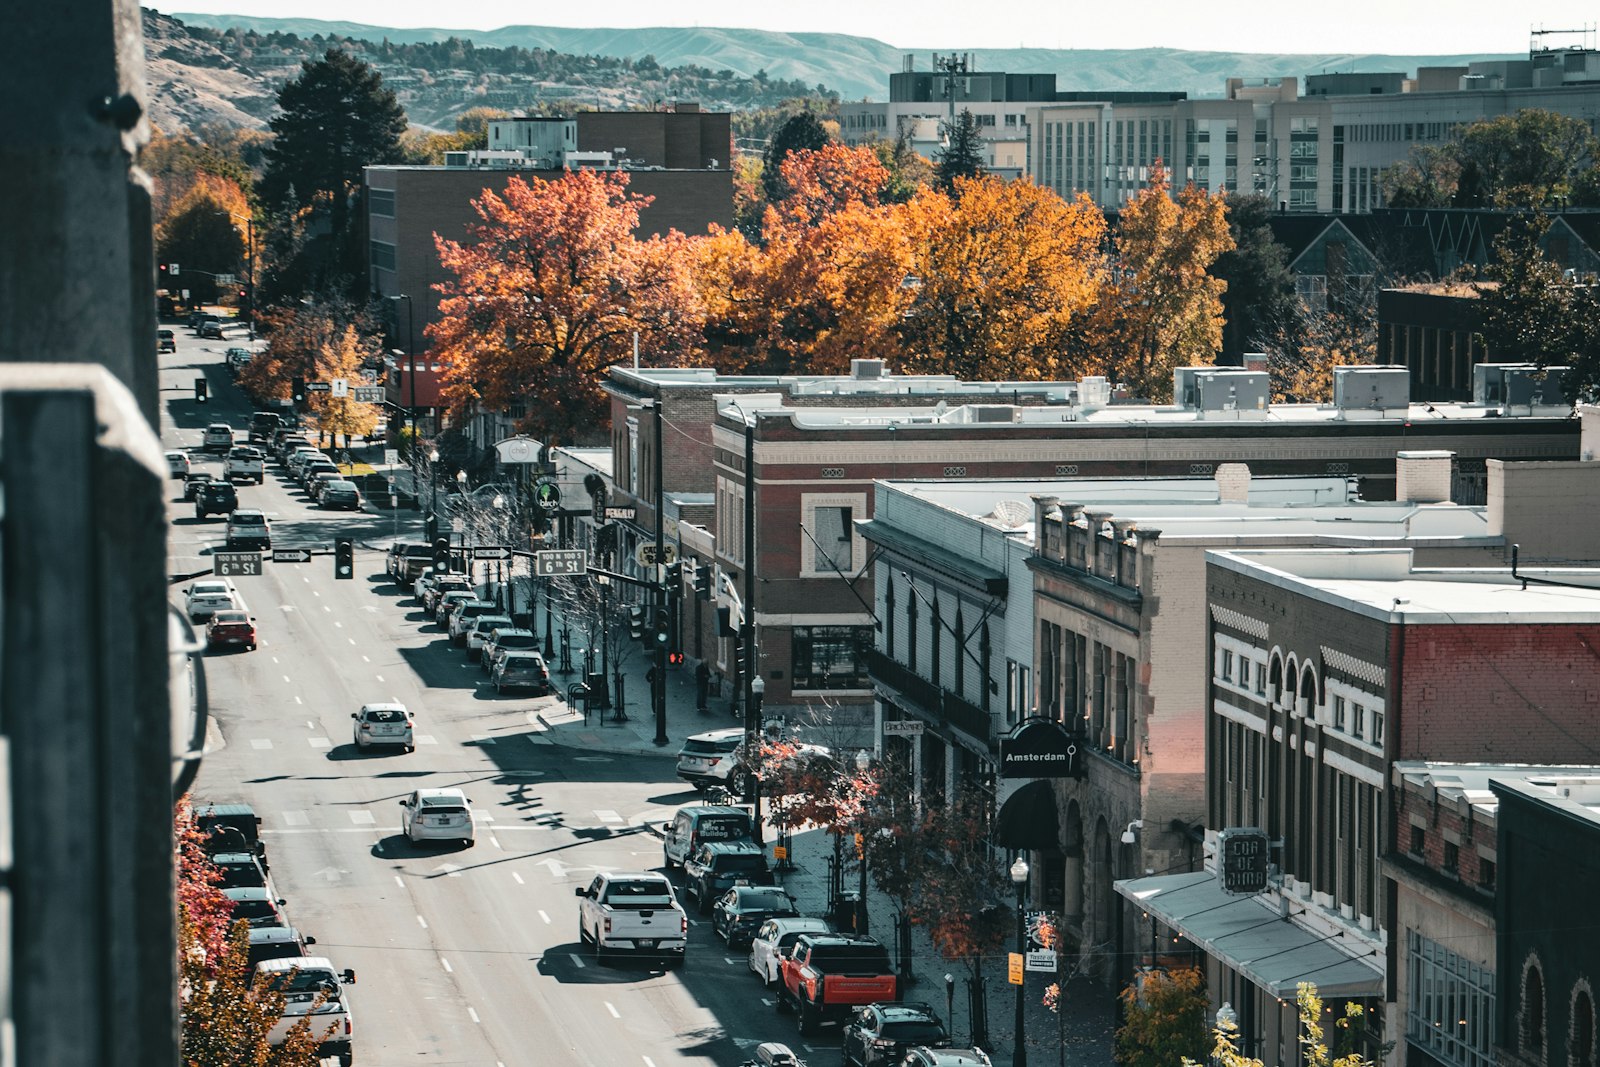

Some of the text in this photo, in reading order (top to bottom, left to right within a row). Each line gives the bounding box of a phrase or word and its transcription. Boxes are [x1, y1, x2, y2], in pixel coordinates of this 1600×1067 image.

[540, 499, 558, 507] birch
[221, 563, 229, 574] 6
[243, 562, 255, 574] St
[545, 561, 553, 573] 6
[566, 560, 578, 572] St
[1006, 753, 1066, 762] Amsterdam
